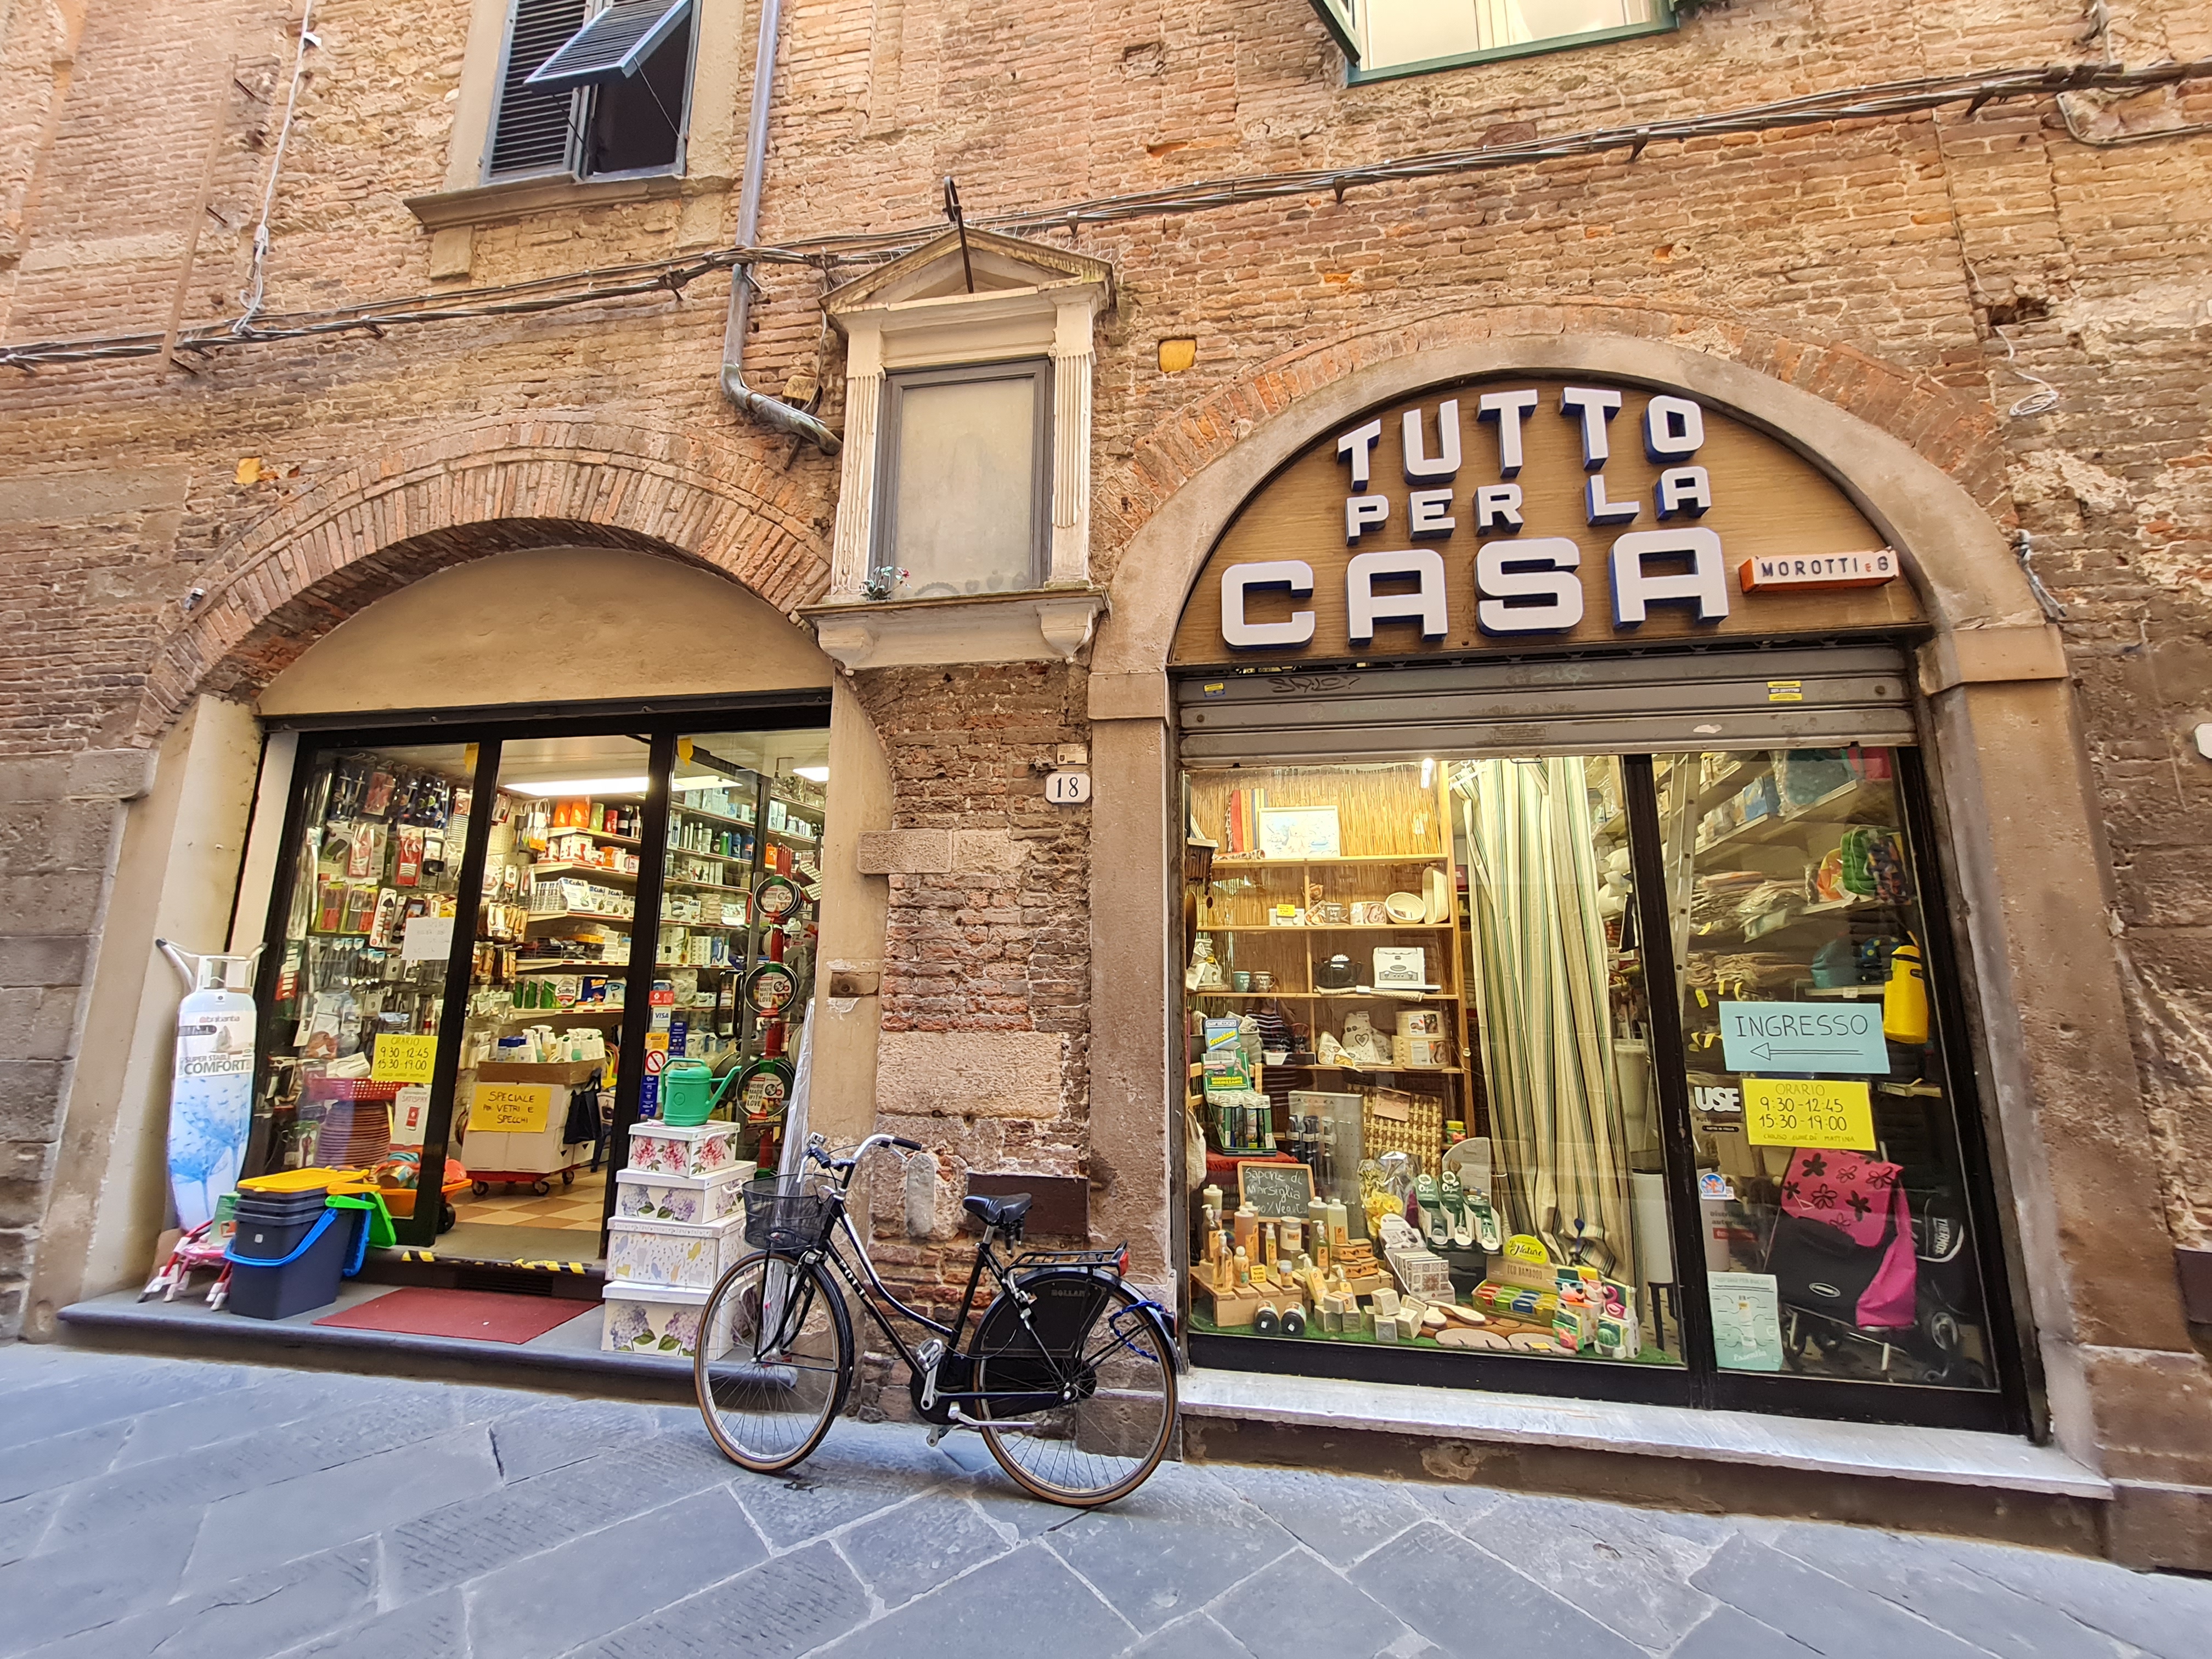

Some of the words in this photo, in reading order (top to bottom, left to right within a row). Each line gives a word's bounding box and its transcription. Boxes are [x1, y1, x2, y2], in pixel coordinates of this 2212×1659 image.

[1336, 386, 1705, 490] TUTTO
[1345, 483, 1524, 545] PER
[1585, 466, 1712, 525] LA
[1761, 557, 1859, 577] MOROTTI
[1220, 527, 1729, 651] CASA
[1057, 777, 1079, 798] 18
[1735, 1014, 1868, 1037] INGRESSO
[184, 1060, 246, 1075] COMFORT
[488, 1091, 535, 1103] SPECIALE
[1694, 1086, 1742, 1113] USE
[1775, 1084, 1825, 1096] ORARIO
[497, 1114, 528, 1124] SPECCHI
[1245, 1167, 1286, 1184] Sapone
[1291, 1171, 1303, 1184] di
[1246, 1184, 1301, 1203] Marsiglia
[1932, 1217, 1951, 1255] THERMOS
[1510, 1244, 1543, 1257] Nature
